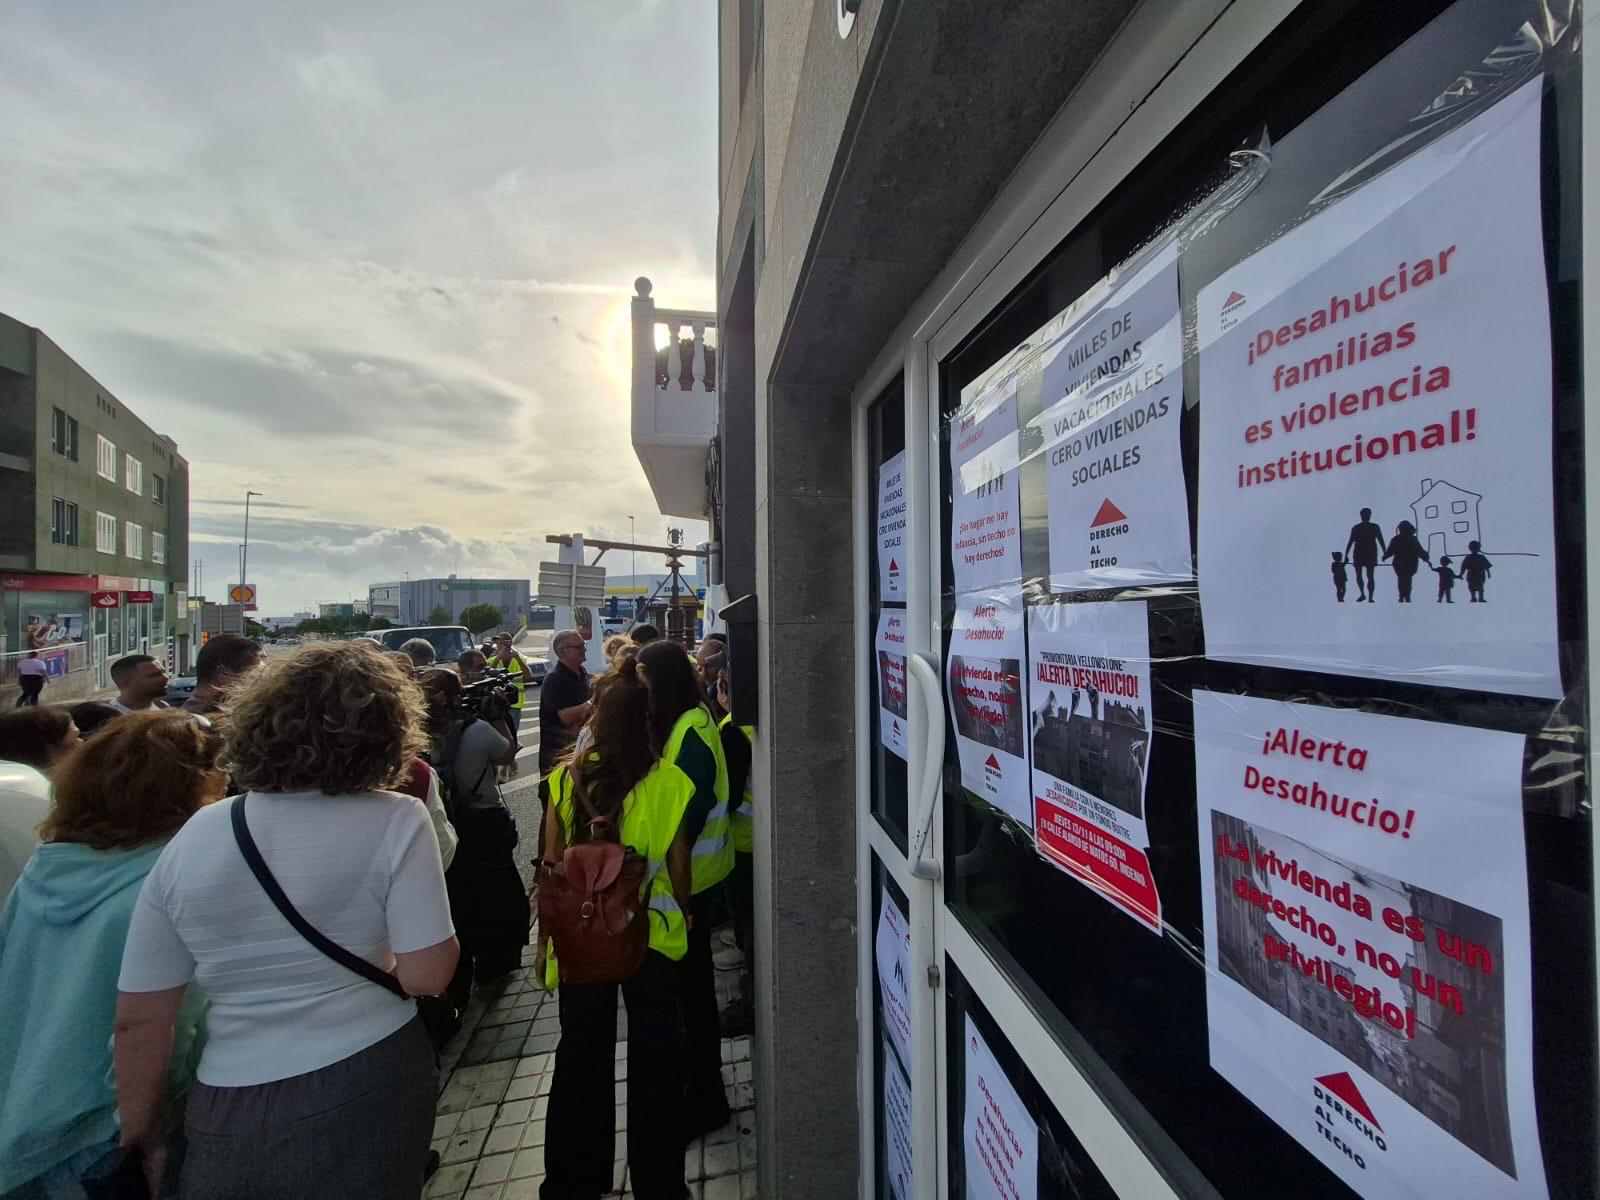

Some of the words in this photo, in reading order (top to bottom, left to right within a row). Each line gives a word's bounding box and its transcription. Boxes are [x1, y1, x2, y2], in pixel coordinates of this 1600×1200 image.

[1248, 244, 1457, 365] ¡Desahuciar
[1068, 329, 1108, 371] MILES
[1112, 312, 1132, 339] DE
[1273, 320, 1416, 392] familias
[1065, 341, 1142, 397] VIVIENDAS
[1054, 363, 1164, 438] VACACIONALES
[1244, 418, 1272, 444] es
[1281, 364, 1450, 434] violencia
[1052, 440, 1082, 468] CERO
[1085, 396, 1170, 450] VIVIENDAS
[1238, 408, 1478, 488] institucional!
[1072, 445, 1141, 488] SOCIALES
[988, 528, 1006, 542] techo
[996, 511, 1008, 522] hay
[1090, 524, 1129, 540] DERECHO
[964, 554, 975, 565] hay
[1090, 545, 1100, 555] AL
[1090, 556, 1118, 568] TECHO
[966, 626, 1004, 640] Desahucio!
[1036, 662, 1071, 687] ¡ALERTA
[1072, 668, 1138, 698] DESAHUCIO!
[1262, 727, 1368, 772] ¡Alerta
[1244, 765, 1416, 840] Desahucio!
[1048, 822, 1061, 838] CALLE
[1072, 822, 1088, 839] 13/11
[1094, 834, 1104, 848] LAS
[1216, 833, 1250, 865] ¡La
[1254, 844, 1372, 921] vivienda
[1382, 906, 1426, 943] es
[1438, 926, 1494, 976] un
[1234, 875, 1347, 956] derecho,
[1354, 938, 1400, 979] no
[1412, 966, 1464, 1016] un
[1264, 932, 1416, 1039] privilegio!
[978, 1075, 1024, 1160] ¡Desahuciar
[1313, 1084, 1388, 1153] DERECHO
[1314, 1105, 1334, 1127] AL
[1316, 1122, 1366, 1171] TECHO
